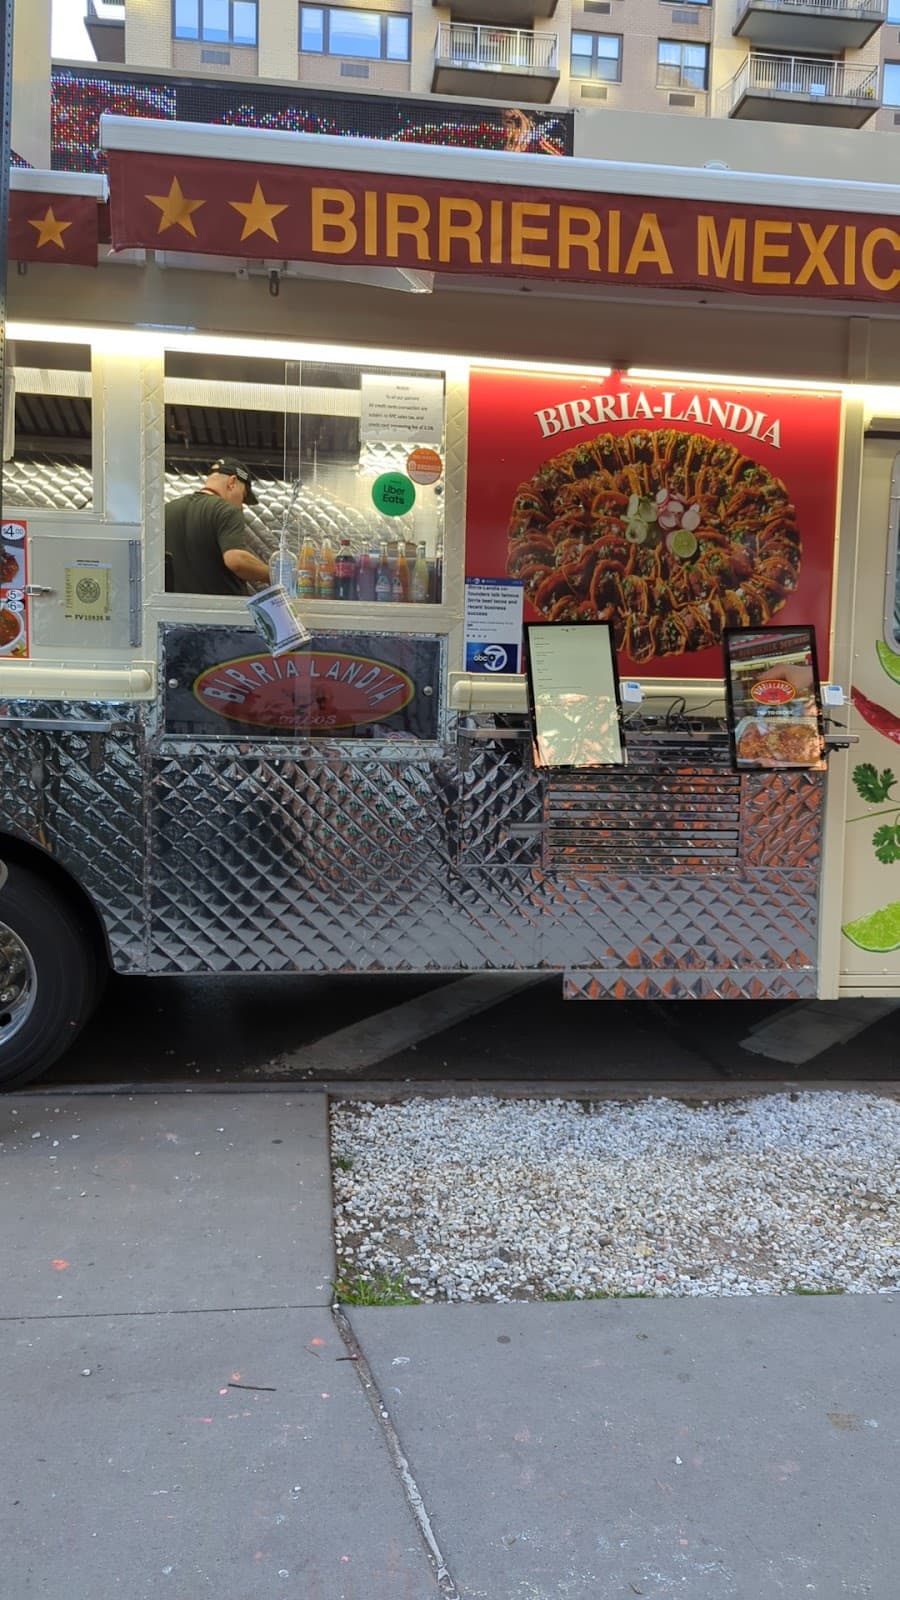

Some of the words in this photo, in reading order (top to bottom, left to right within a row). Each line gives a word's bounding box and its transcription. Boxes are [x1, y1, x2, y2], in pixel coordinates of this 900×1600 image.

[311, 187, 674, 277] BIRRIERIA
[697, 215, 900, 291] MEXIC
[533, 391, 782, 448] BIRRIA-LANDIA
[383, 484, 405, 496] Uber
[383, 494, 405, 504] Eats
[473, 654, 488, 662] abc
[203, 660, 300, 704] BIRRIA
[309, 660, 405, 706] LANDIA
